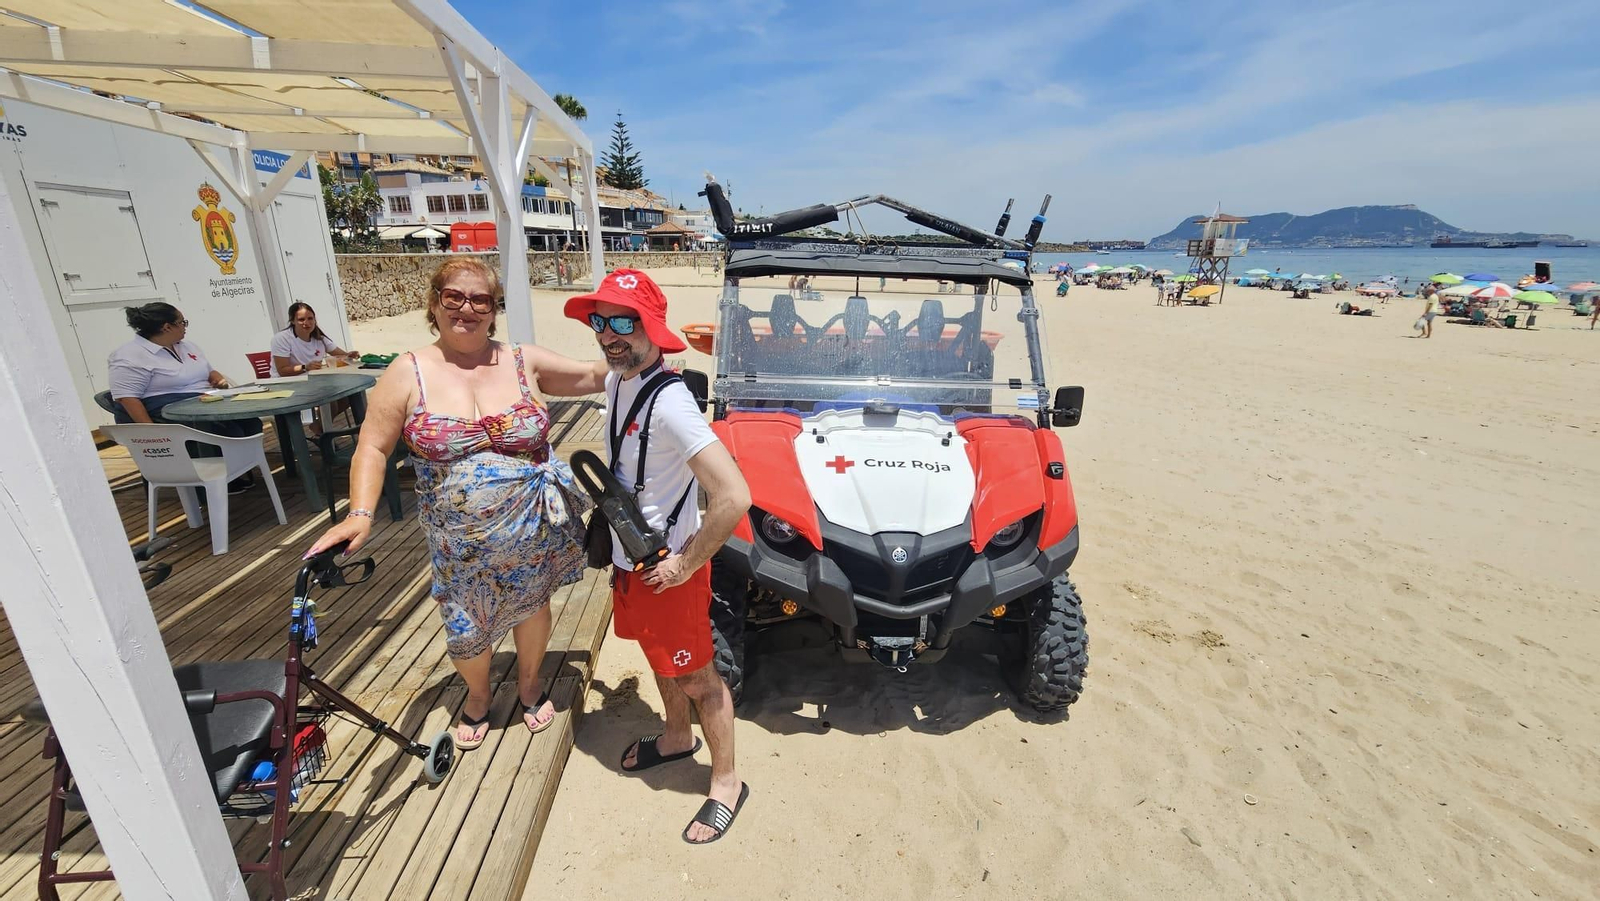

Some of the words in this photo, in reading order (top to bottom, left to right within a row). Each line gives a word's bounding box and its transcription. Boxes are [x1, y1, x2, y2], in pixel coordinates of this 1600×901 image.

[253, 153, 277, 168] OLICIA
[733, 223, 773, 234] ITIWIT
[209, 277, 253, 288] Ayuntamiento
[211, 289, 221, 298] de
[221, 286, 255, 298] Algeciras
[864, 458, 907, 468] Cruz
[911, 460, 951, 473] Roja
